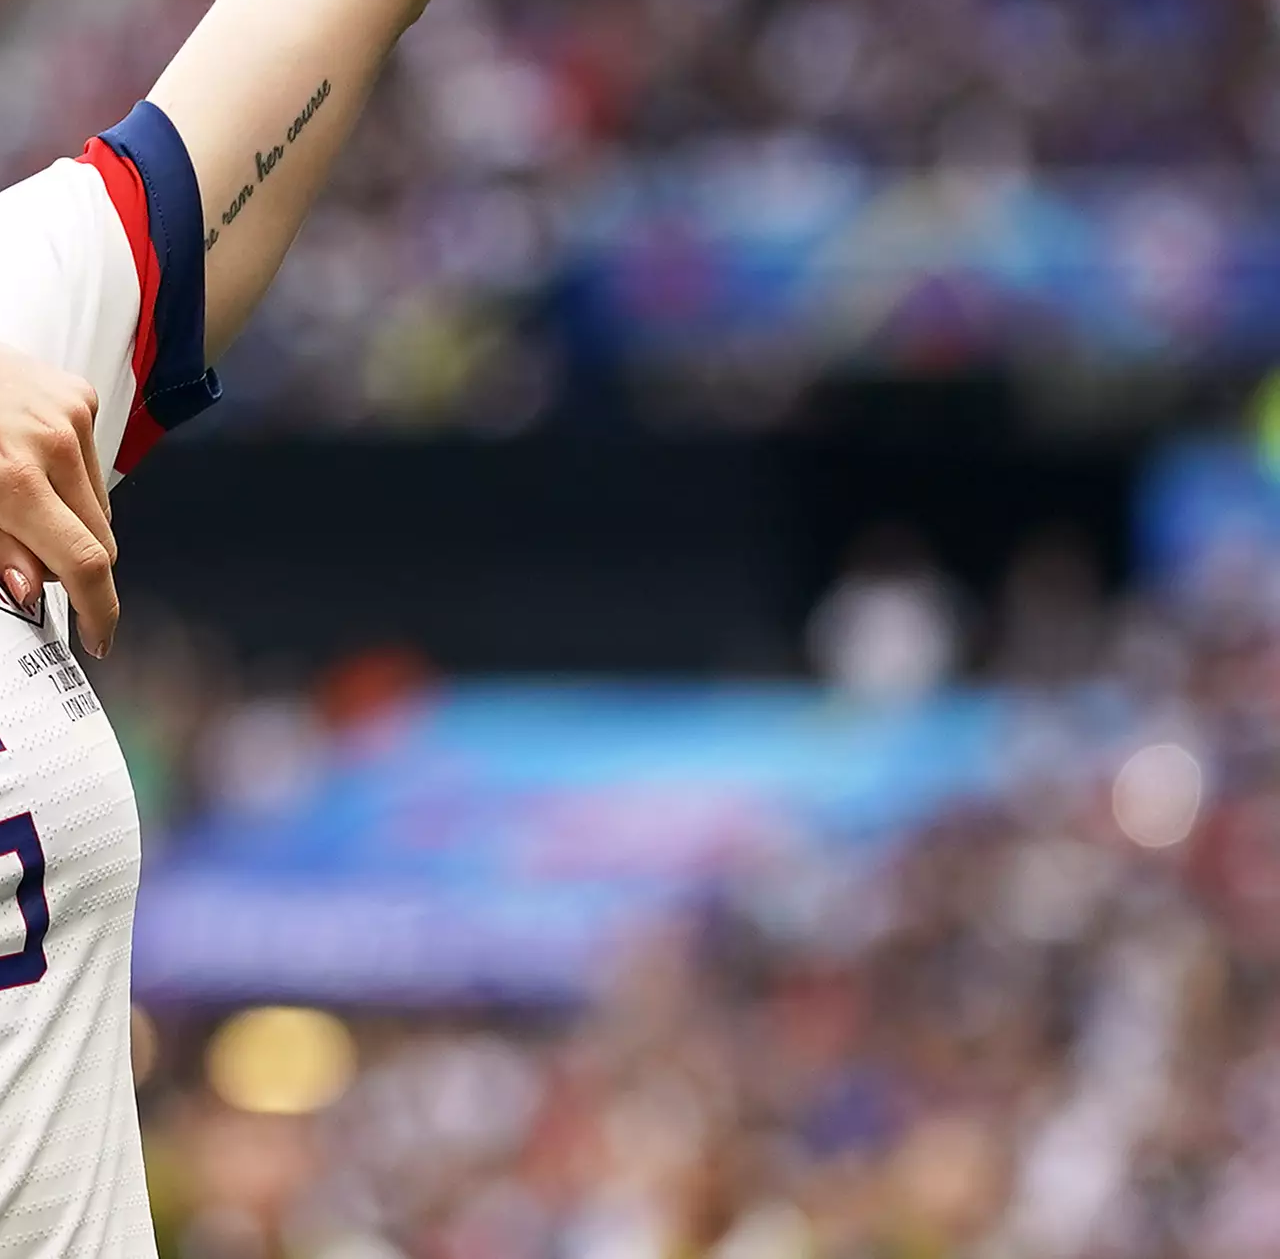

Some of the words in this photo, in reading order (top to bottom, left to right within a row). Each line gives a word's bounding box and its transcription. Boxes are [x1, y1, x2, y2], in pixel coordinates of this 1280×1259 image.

[222, 184, 254, 226] ran
[255, 144, 285, 183] her
[286, 78, 332, 144] course
